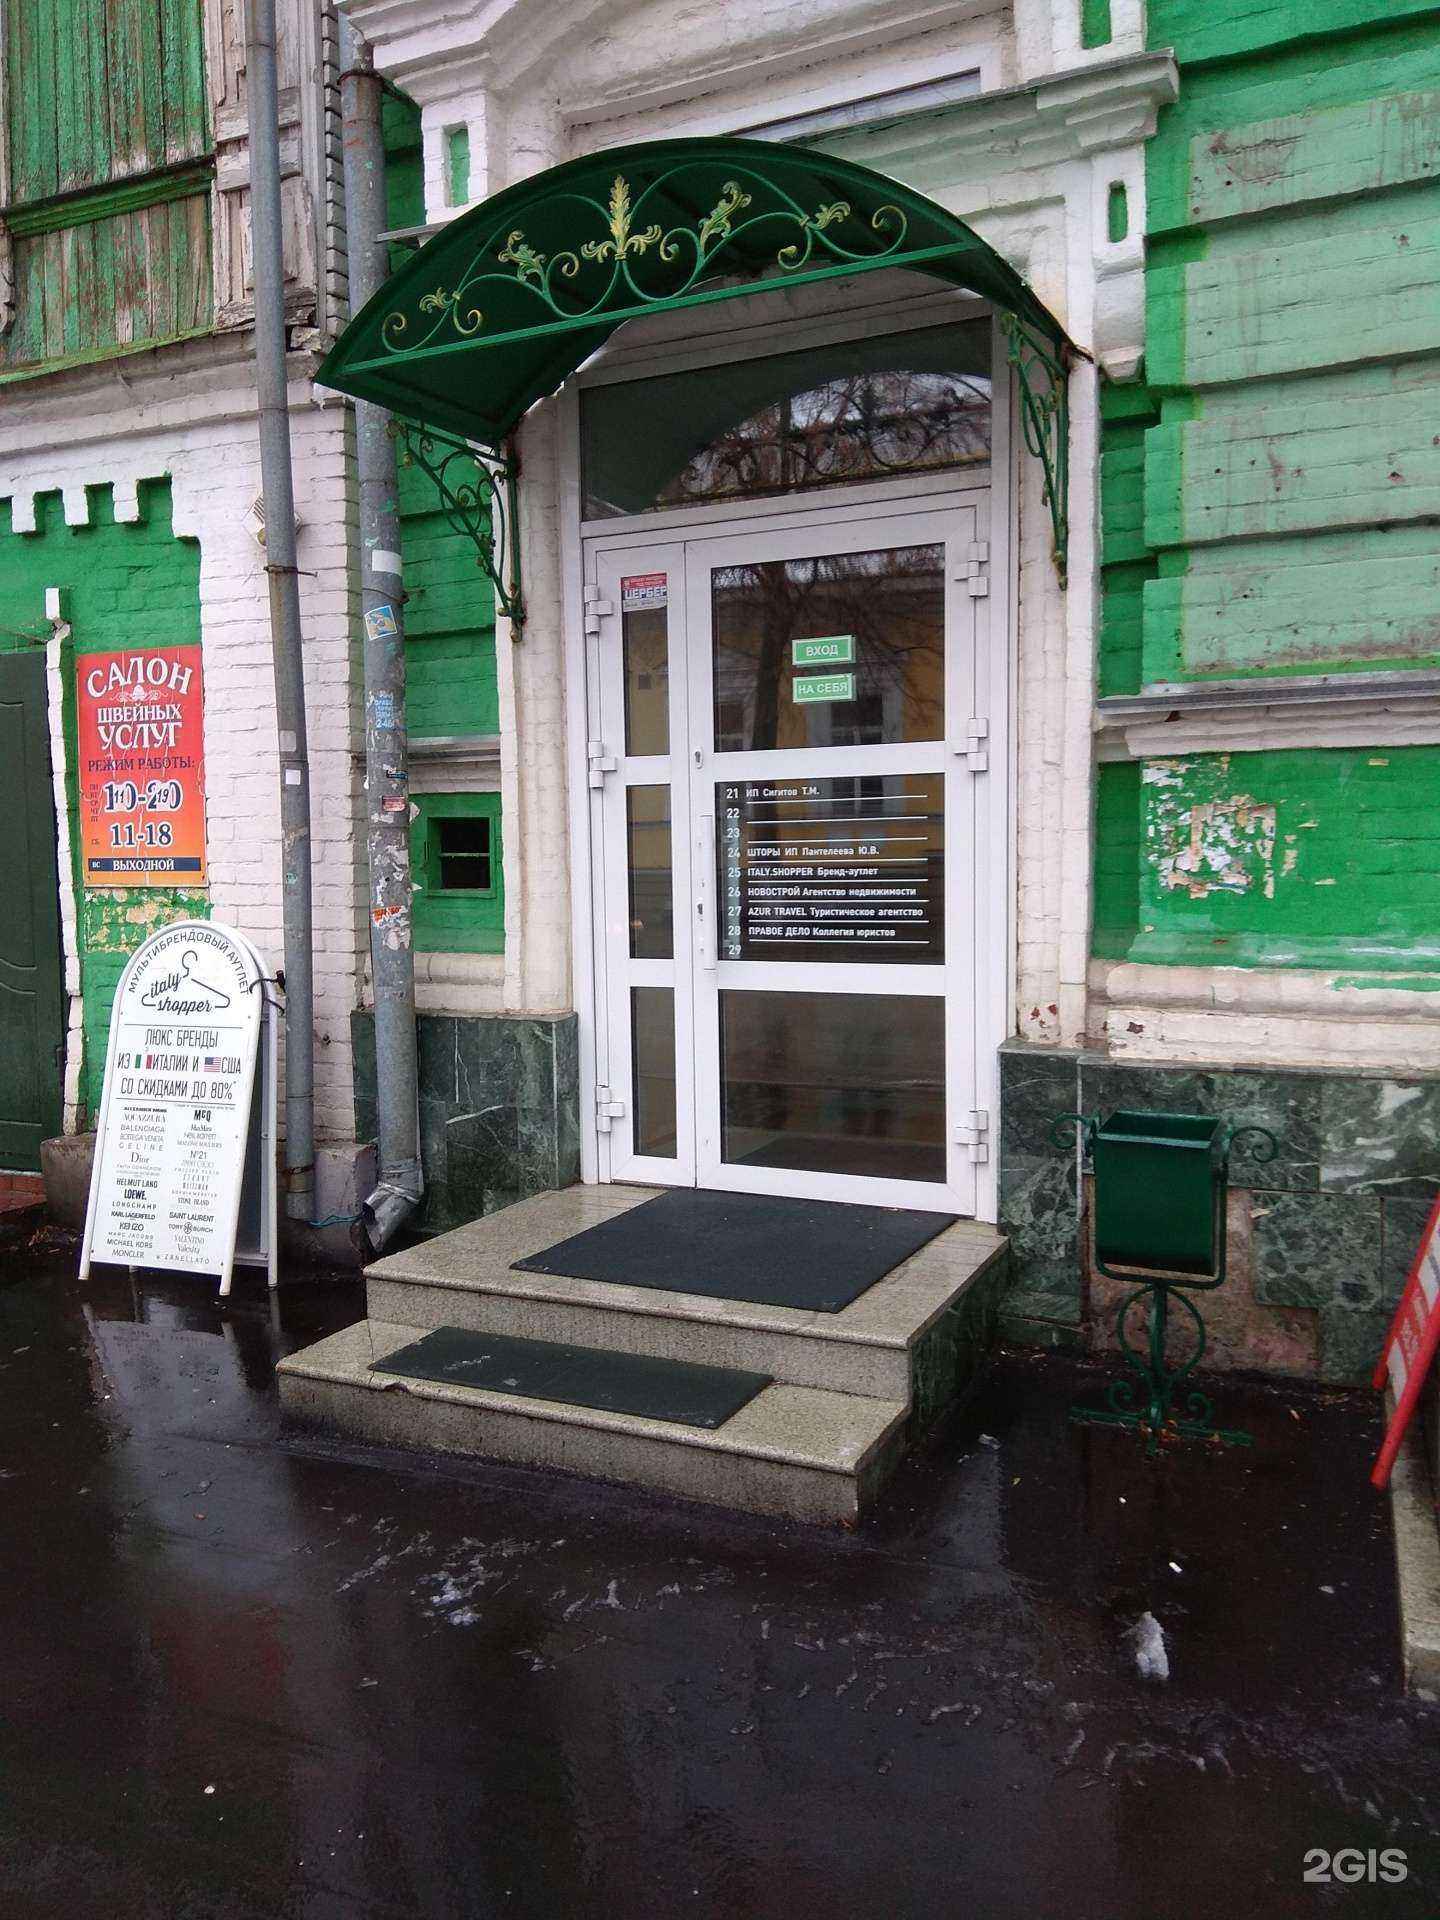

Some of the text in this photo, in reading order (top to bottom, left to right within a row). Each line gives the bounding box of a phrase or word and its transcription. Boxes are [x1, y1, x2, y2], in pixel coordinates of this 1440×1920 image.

[806, 645, 838, 656] ВХОД
[88, 656, 192, 697] САЛОН
[799, 682, 847, 693] НА СЕБЯ
[97, 702, 182, 723] ШВЕЙНЫХ
[97, 721, 182, 750] УСЛУГ
[88, 756, 195, 771] РЕЖИМ РАБОТЫ:
[726, 788, 738, 798] 21
[746, 789, 759, 797] ИП
[802, 787, 819, 795] Т.М.
[726, 808, 740, 818] 22
[112, 824, 171, 845] 11-18
[727, 828, 740, 838] 23
[728, 848, 740, 857] 24
[748, 848, 780, 856] ШТОРЫ
[803, 847, 854, 856] Пантелеева
[859, 846, 879, 854] Ю.В.
[113, 859, 174, 870] ВЫХОДНОЙ
[728, 867, 878, 877] 25 ITALY.SHOPPER Бренд-аутлет
[728, 887, 741, 896] 26
[748, 886, 800, 896] НОВОСТРОЙ
[802, 888, 846, 896] Агентство
[728, 906, 741, 916] 27
[810, 907, 875, 917] Туристическое
[728, 926, 895, 937] 28 ПРАВОЕ ДЕЛО Коллегия юристов
[729, 945, 741, 954] 29
[129, 930, 249, 995] МУЛЬТИБРЕНДОВЫЙ АУТЛЕТ
[150, 973, 181, 998] italy
[158, 996, 212, 1015] shopper
[145, 1029, 218, 1049] ЛЮКС БРЕНДЫ
[118, 1053, 241, 1074] ИЗ ИТАЛИИ И США
[120, 1078, 134, 1094] СО
[138, 1078, 187, 1098] СКИДКАМИ
[191, 1082, 206, 1099] ДО
[116, 1178, 141, 1188] HELMUT
[112, 1201, 157, 1210] LONGCHAMP
[169, 1211, 214, 1223] SAINT LAURENT
[107, 1239, 153, 1249] MICHAEL KORS
